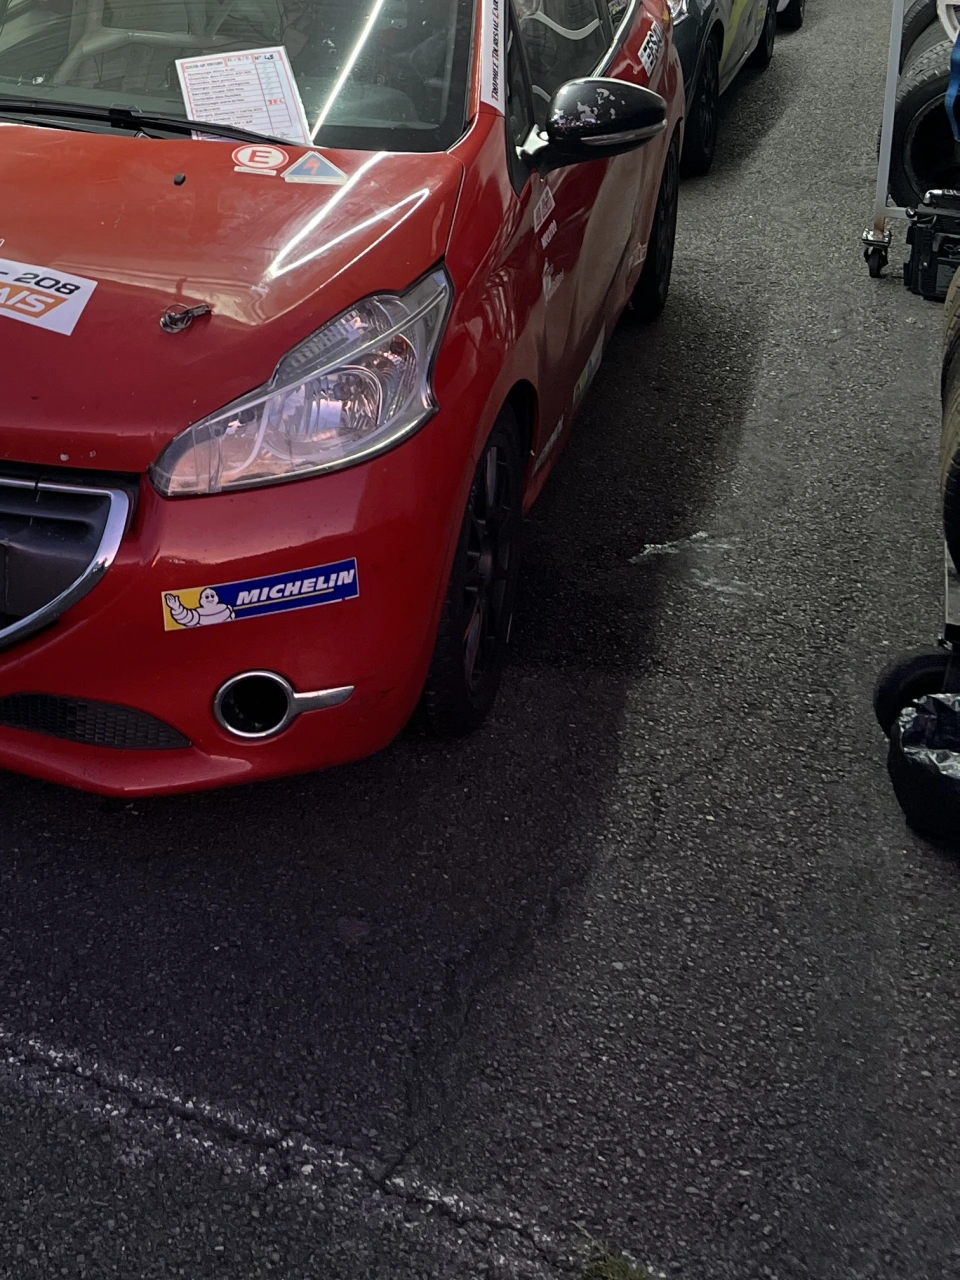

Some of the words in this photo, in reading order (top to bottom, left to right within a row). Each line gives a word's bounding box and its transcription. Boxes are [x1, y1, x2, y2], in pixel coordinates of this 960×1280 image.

[248, 149, 272, 164] E
[13, 272, 81, 296] 208
[236, 569, 355, 606] MICHELIN
